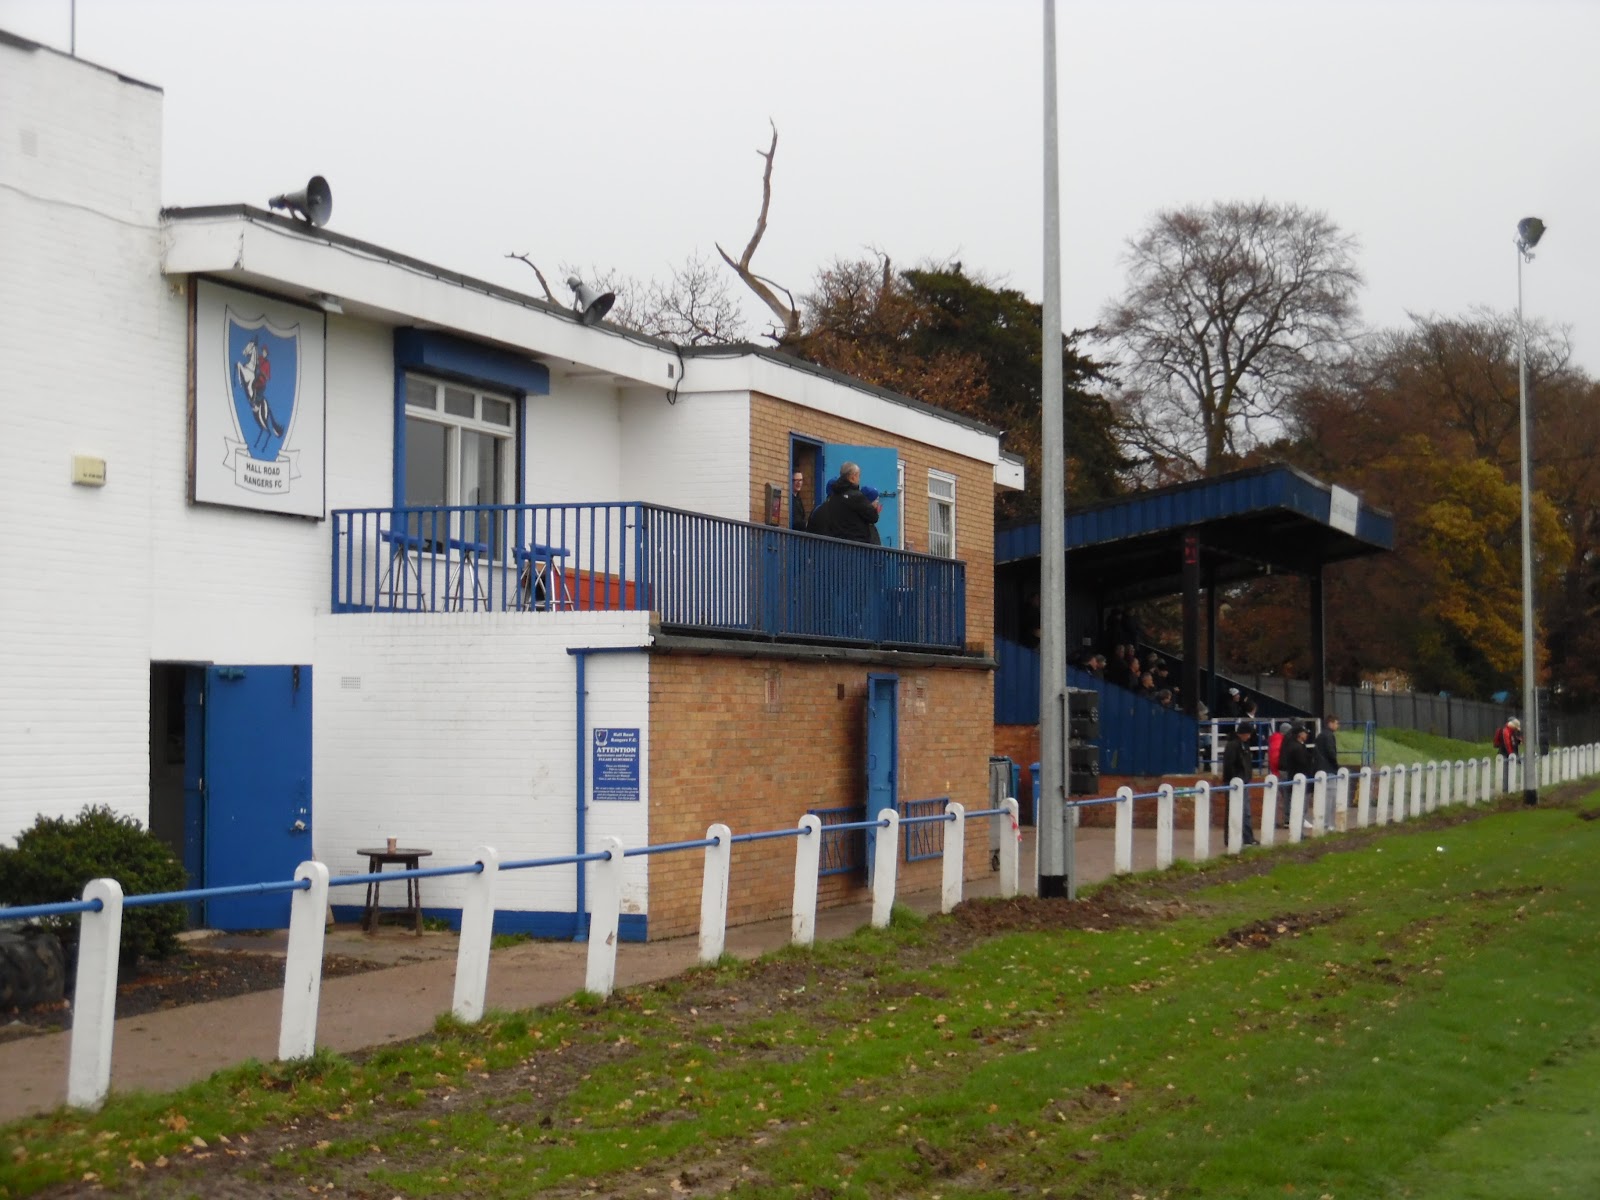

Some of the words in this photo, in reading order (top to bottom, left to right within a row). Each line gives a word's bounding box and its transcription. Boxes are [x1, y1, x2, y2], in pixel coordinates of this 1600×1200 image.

[246, 463, 261, 474] HALL
[264, 466, 280, 475] ROAD
[244, 474, 273, 488] RANGERS
[274, 480, 282, 488] FC
